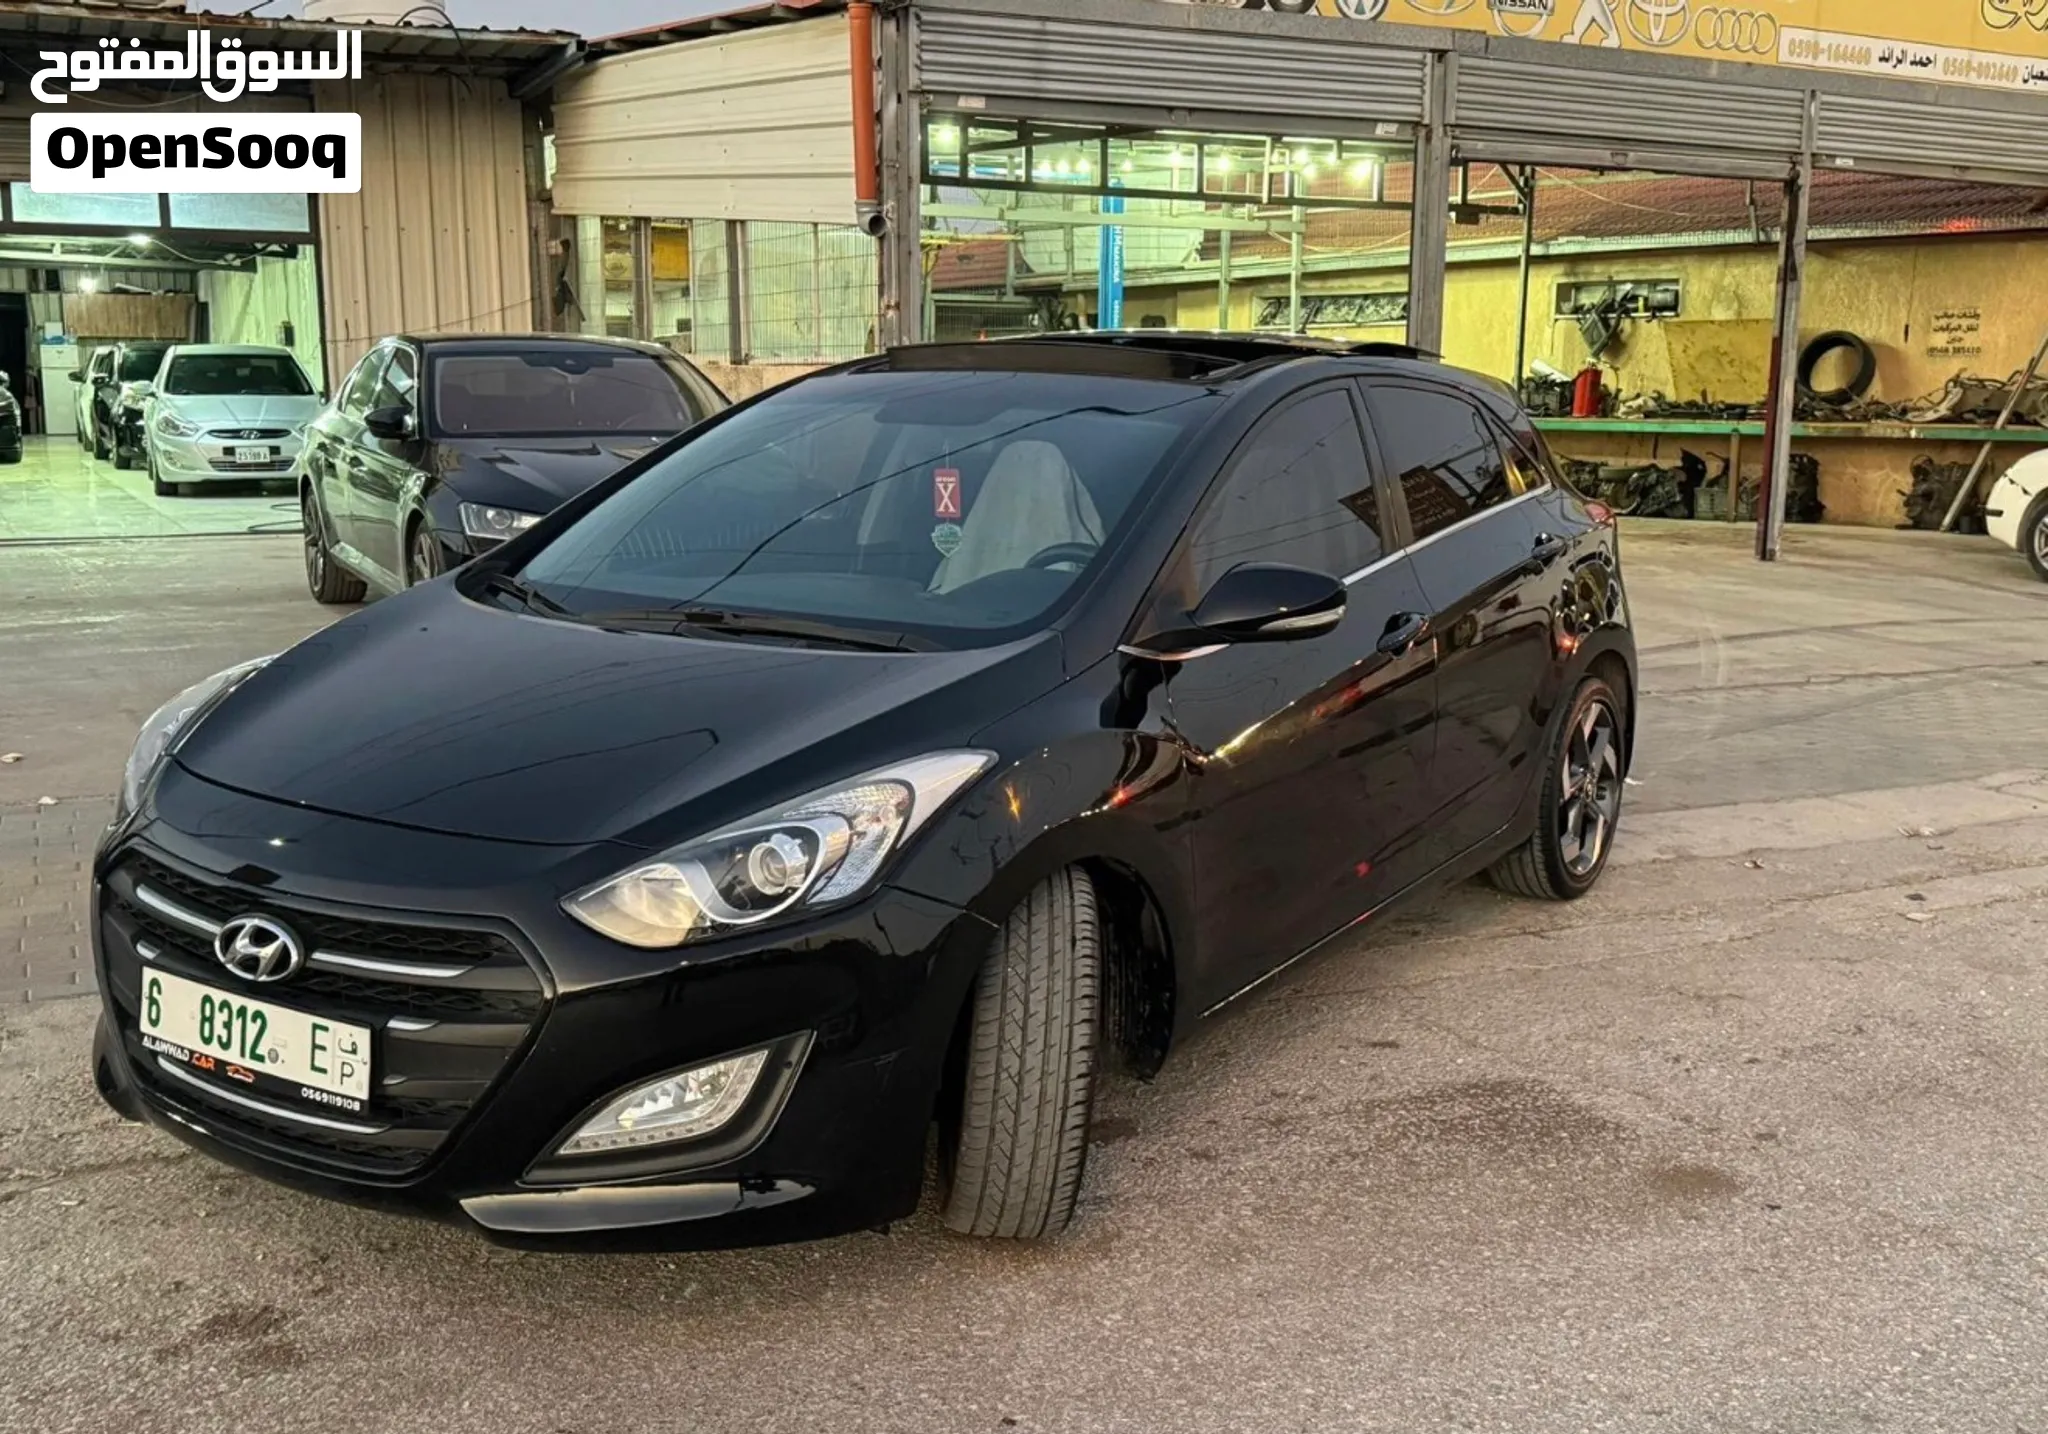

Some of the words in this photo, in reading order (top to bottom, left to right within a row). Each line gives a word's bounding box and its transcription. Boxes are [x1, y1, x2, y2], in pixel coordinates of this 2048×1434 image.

[147, 977, 162, 1028] 6
[199, 993, 268, 1064] 8312
[310, 1022, 330, 1075] E
[191, 1052, 216, 1072] CAR
[340, 1060, 355, 1086] P
